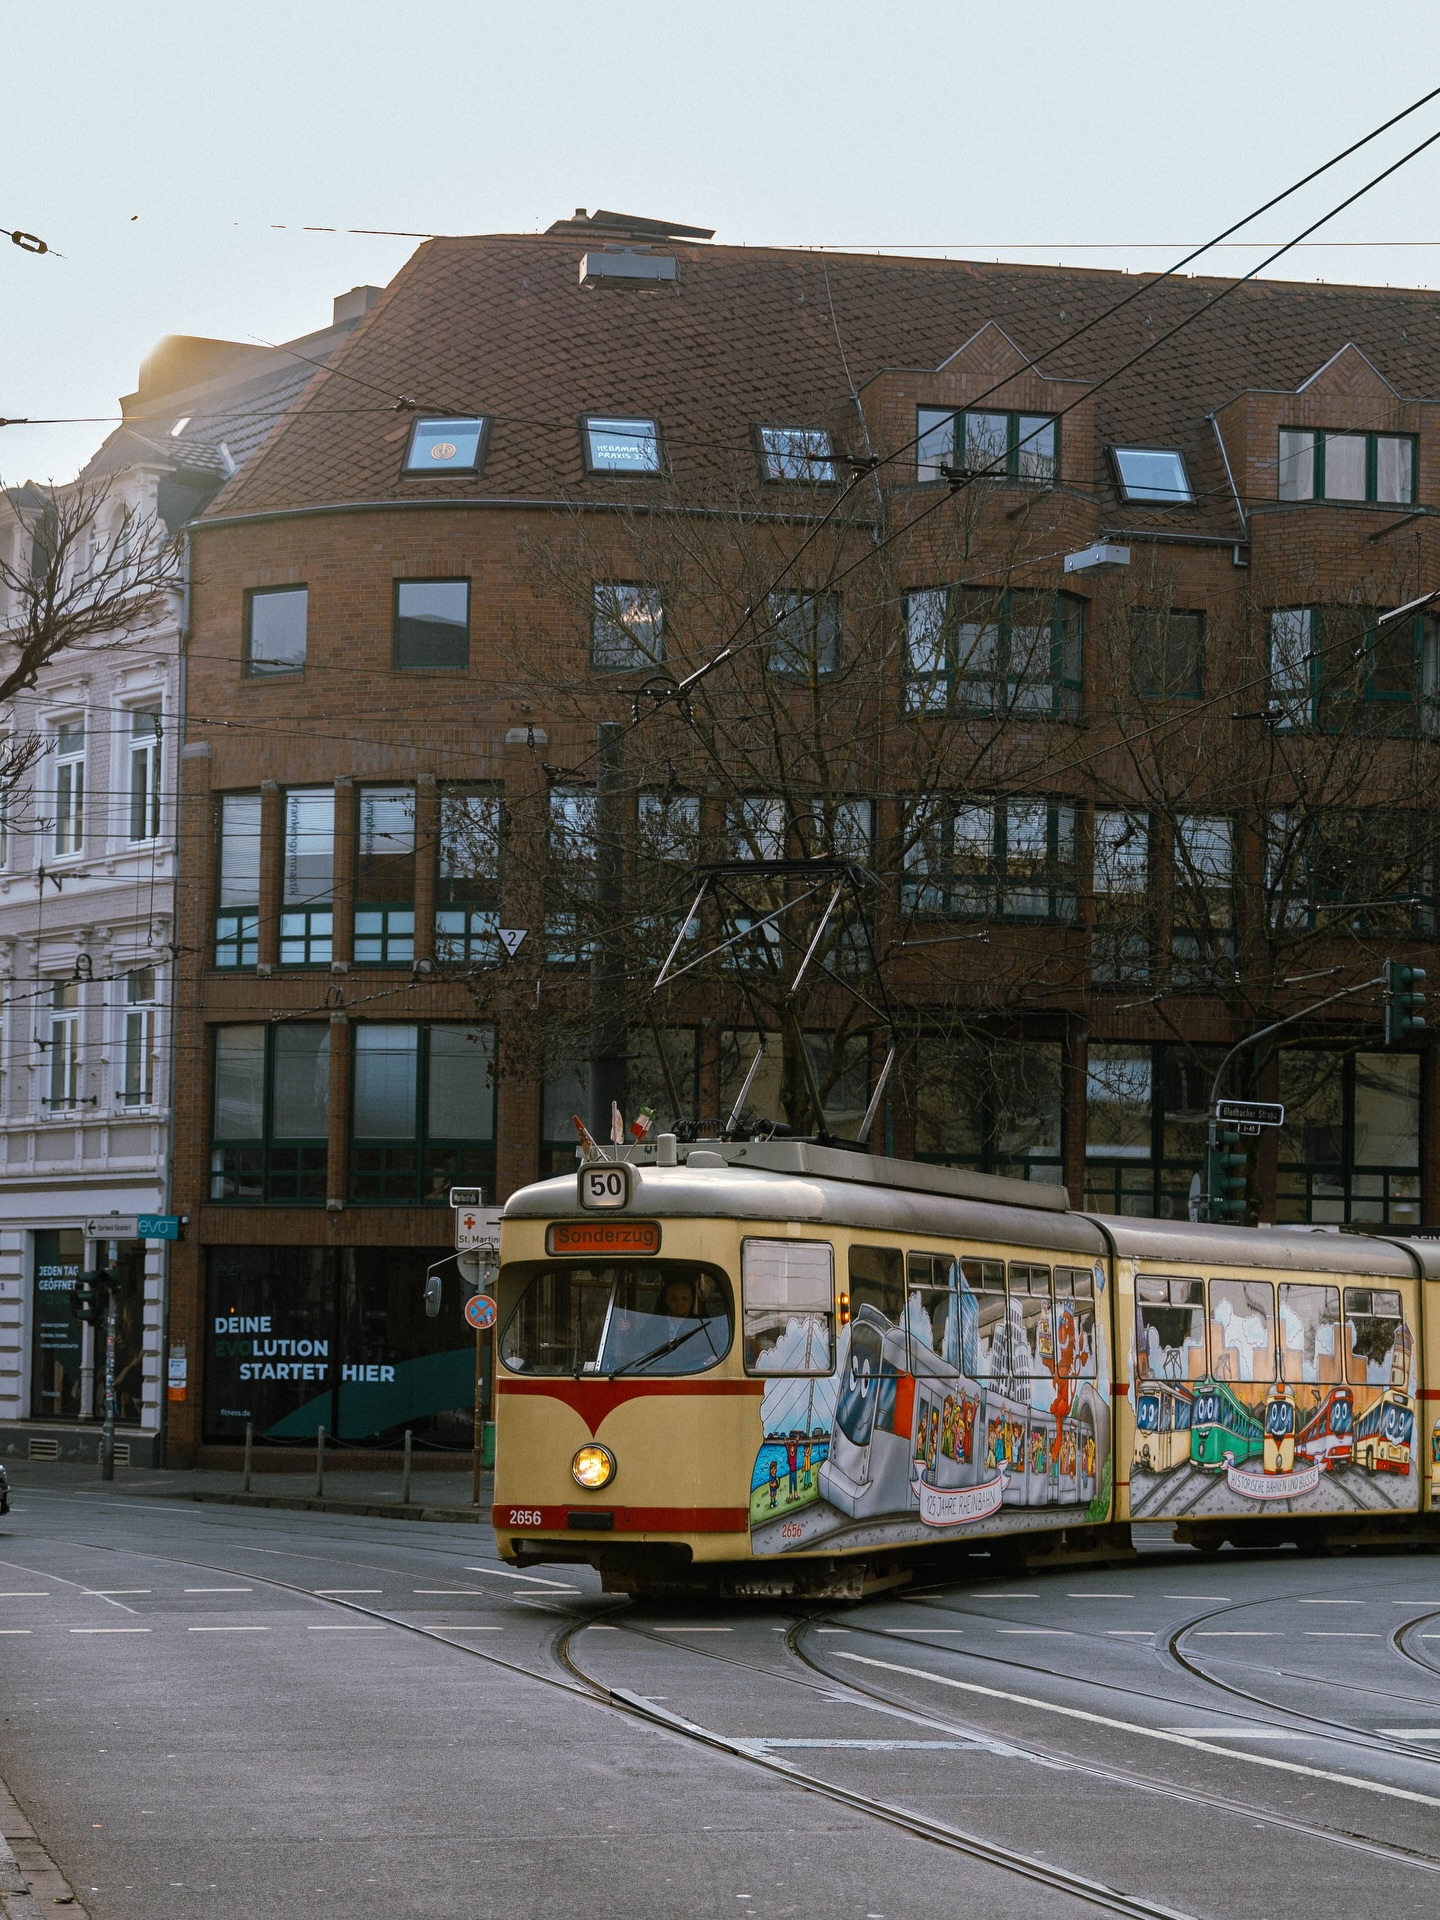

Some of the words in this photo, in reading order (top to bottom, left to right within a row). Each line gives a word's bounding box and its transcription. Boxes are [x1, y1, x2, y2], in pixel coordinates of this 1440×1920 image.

[598, 452, 631, 460] PRAXIS
[287, 797, 300, 897] Krankengymnastik
[507, 931, 516, 947] 2
[1223, 1106, 1256, 1118] Gladbacher
[590, 1173, 622, 1197] 50
[139, 1220, 176, 1233] evo
[458, 1235, 470, 1243] St.
[472, 1235, 500, 1244] Martin
[559, 1227, 654, 1246] Sonderzug
[39, 1265, 62, 1276] JEDEN
[64, 1265, 79, 1276] TAG
[39, 1277, 77, 1290] GEÖFFNET
[215, 1316, 272, 1333] DEINE
[240, 1363, 328, 1380] STARTET
[342, 1364, 395, 1382] HIER
[1231, 1474, 1264, 1493] HISTORISCHE
[1266, 1478, 1287, 1493] BAHNEN
[1288, 1477, 1298, 1491] UND
[936, 1496, 957, 1516] JAHRE
[509, 1509, 542, 1525] 2656
[781, 1523, 802, 1538] 2656
